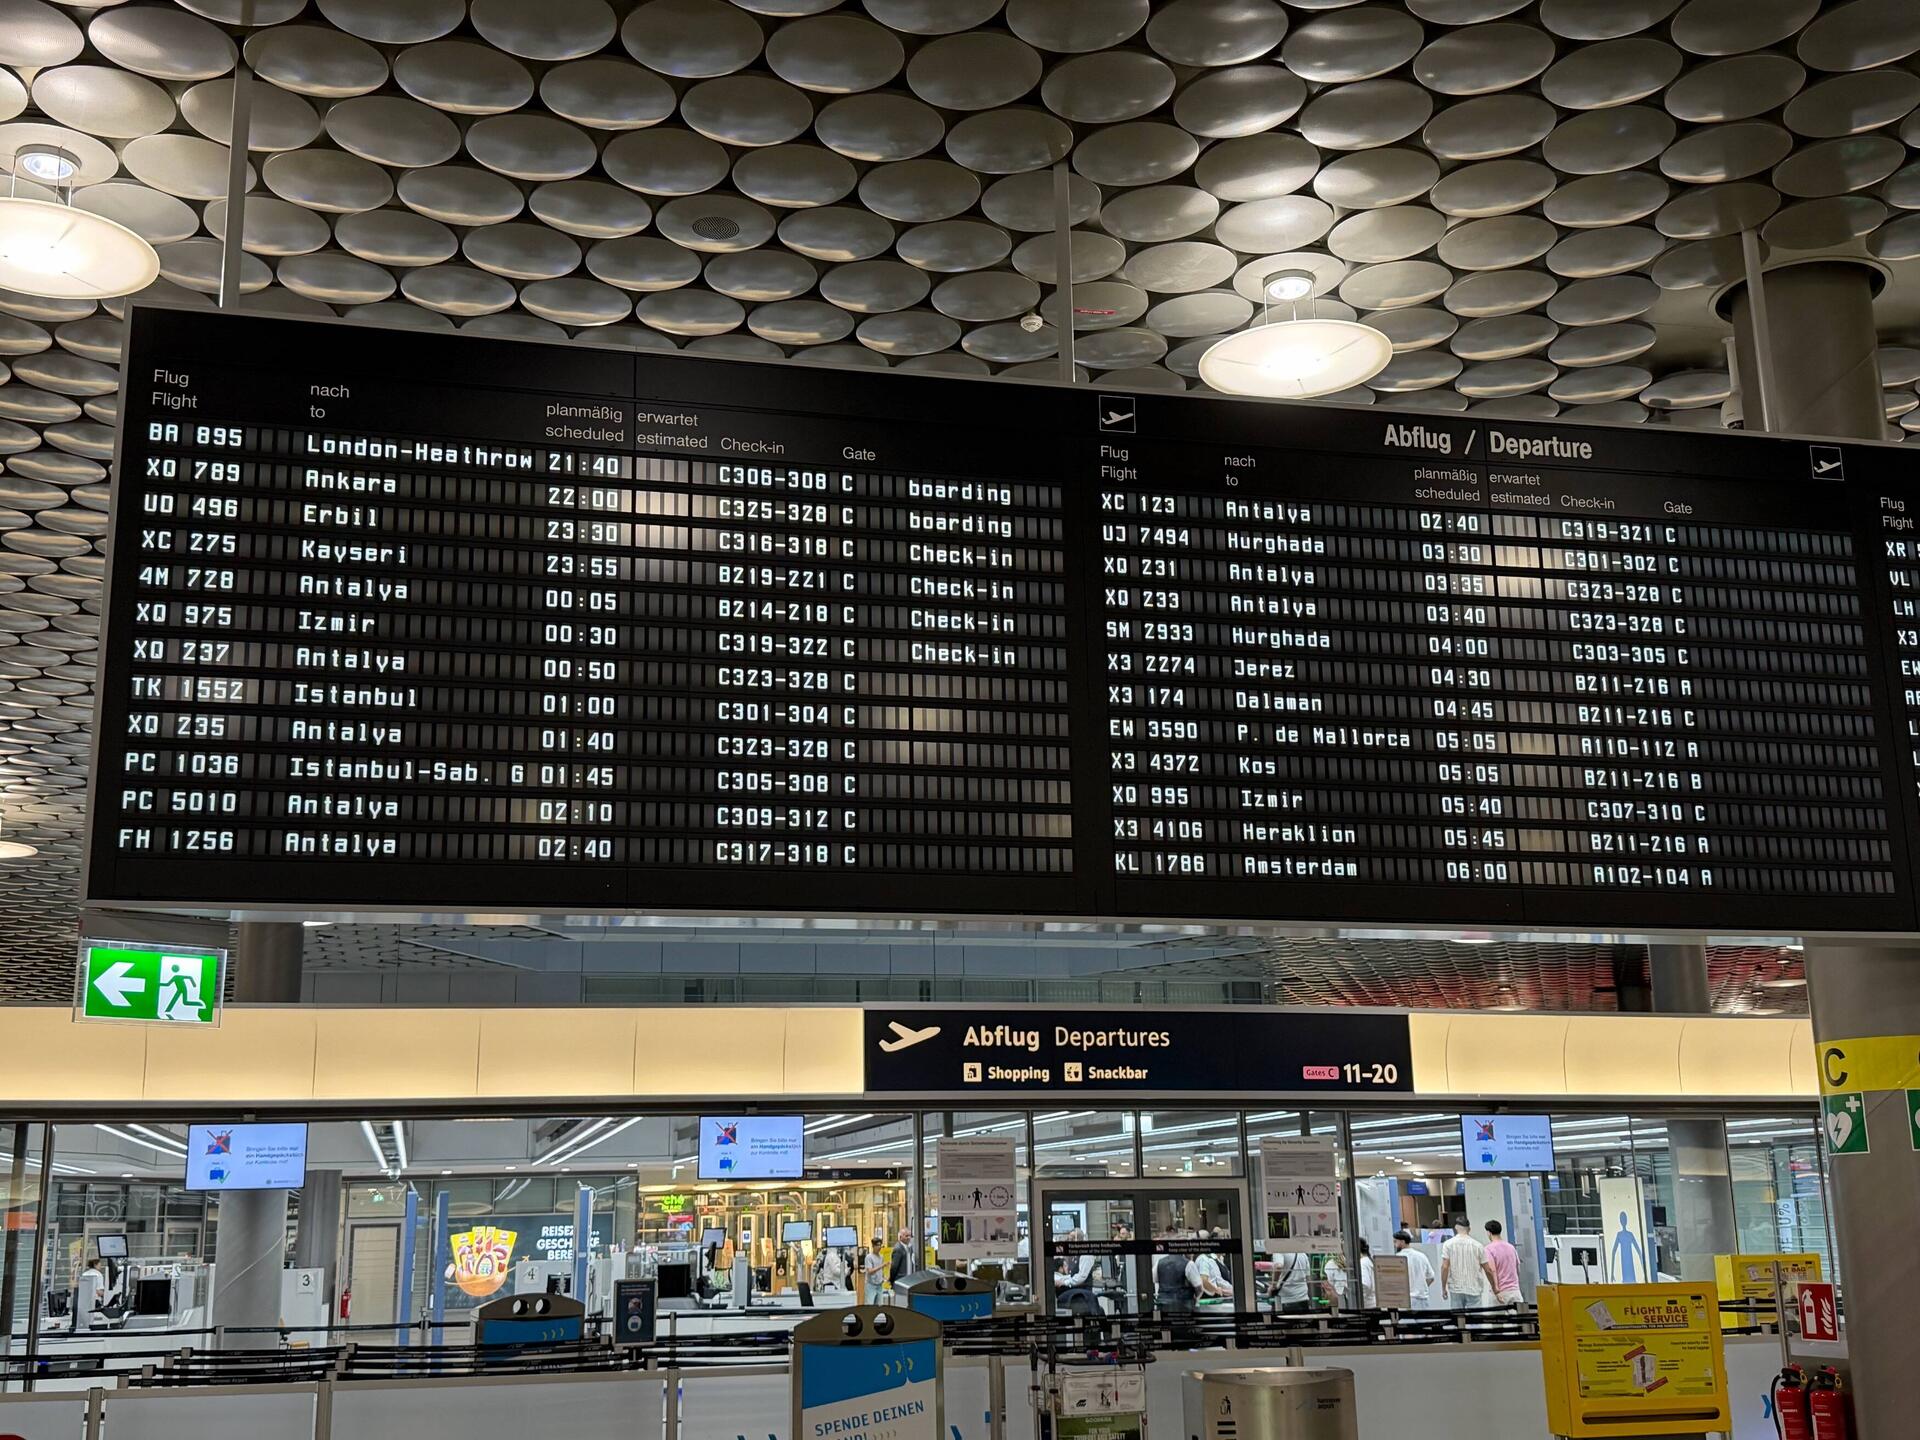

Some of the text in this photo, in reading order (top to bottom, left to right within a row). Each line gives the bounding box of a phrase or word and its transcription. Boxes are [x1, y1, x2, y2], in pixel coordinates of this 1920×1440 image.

[154, 369, 188, 387] Flug
[153, 392, 197, 409] Flight
[311, 385, 349, 398] nach
[310, 405, 325, 418] to
[547, 403, 622, 423] planmäßig
[638, 413, 698, 426] erwartet
[546, 425, 623, 441] scheduled
[637, 433, 707, 448] estimated
[1385, 424, 1592, 459] Abflug Departure
[721, 438, 784, 454] Check-in
[843, 447, 875, 460] Gate
[1101, 446, 1128, 461] Flug
[150, 423, 1010, 505] BA 895 London-Heathrow 21:40 C306-308 boarding
[1225, 456, 1255, 467] nach
[1102, 466, 1136, 481] Flight
[1226, 475, 1238, 486] to
[1415, 467, 1477, 484] planmäßig
[1490, 474, 1540, 485] erwartet
[195, 462, 1011, 537] 789 Ankara 22:00 C325-328 boarding
[1416, 487, 1480, 501] scheduled
[1491, 492, 1550, 505] estimated
[1561, 495, 1614, 509] Check-in
[1664, 502, 1692, 514] Gate
[1881, 497, 1904, 511] Flug
[1142, 496, 1650, 541] 123 Antalya 02:40 C319-321
[1883, 516, 1913, 530] Flight
[193, 498, 1012, 566] 496 Erbil 23:30 C316-318 Check-in
[1141, 528, 1656, 571] 7494 Hurghada 03:30 C301-302
[1886, 542, 1906, 557] XR
[191, 533, 1013, 599] 275 Kayseri 23:55 B219-221 Check-in
[1142, 559, 1659, 601] 231 Antalya 03:35 C323-328
[1890, 571, 1909, 586] VL
[140, 567, 1013, 631] 4M 728 Antalya 00:05 B214-218 Check-in
[1894, 601, 1913, 615] LH
[1144, 591, 1662, 632] 233 Antalya 03:40 C323-328
[186, 606, 1014, 664] 975 Izmir 00:30 C319-322 Check-in
[1145, 623, 1665, 663] 2933 Hurghada 04:00 C303-305
[183, 642, 827, 689] 237 Antalya 00:50 C323-328
[1146, 656, 1668, 694] 2274 Jerez 04:30 B211-216
[184, 680, 827, 723] 1552 Istanbul 01:00 C301-304
[1150, 688, 1183, 705] 174
[1435, 701, 1492, 718] 04:45
[1579, 706, 1671, 725] B211-216
[178, 717, 827, 757] 235 Antalya 01:40 C323-328
[1149, 721, 1675, 756] 3590 P. de Mallorca 05:05 A110-112
[179, 754, 238, 774] 1036
[291, 758, 488, 781] Istanbul-Sab.
[542, 766, 613, 785] 01:45
[718, 772, 828, 792] C305-308
[1151, 754, 1678, 788] 4372 Kos 05:05 B211-216
[173, 792, 827, 827] 5010 Antalya 02:10 C309-312
[1152, 787, 1681, 820] 995 Izmir 05:40 C307-310
[1154, 821, 1685, 852] 4106 Heraklion 05:45 B211-216
[173, 831, 827, 862] 1256 Antalya 02:40 C317-318
[1157, 855, 1688, 884] 1786 Amsterdam 06:00 A102-104
[964, 1026, 1169, 1051] Abflug Departures
[989, 1066, 1049, 1082] Shopping
[1089, 1066, 1148, 1078] Snackbar
[1305, 1064, 1397, 1083] Gates C 11-20
[1824, 1048, 1848, 1086] C
[301, 1273, 311, 1287] 3
[1624, 1304, 1688, 1316] FLIGHT BAG
[1643, 1313, 1689, 1324] SERVICE
[814, 1400, 925, 1437] SPENDE DEINEN
